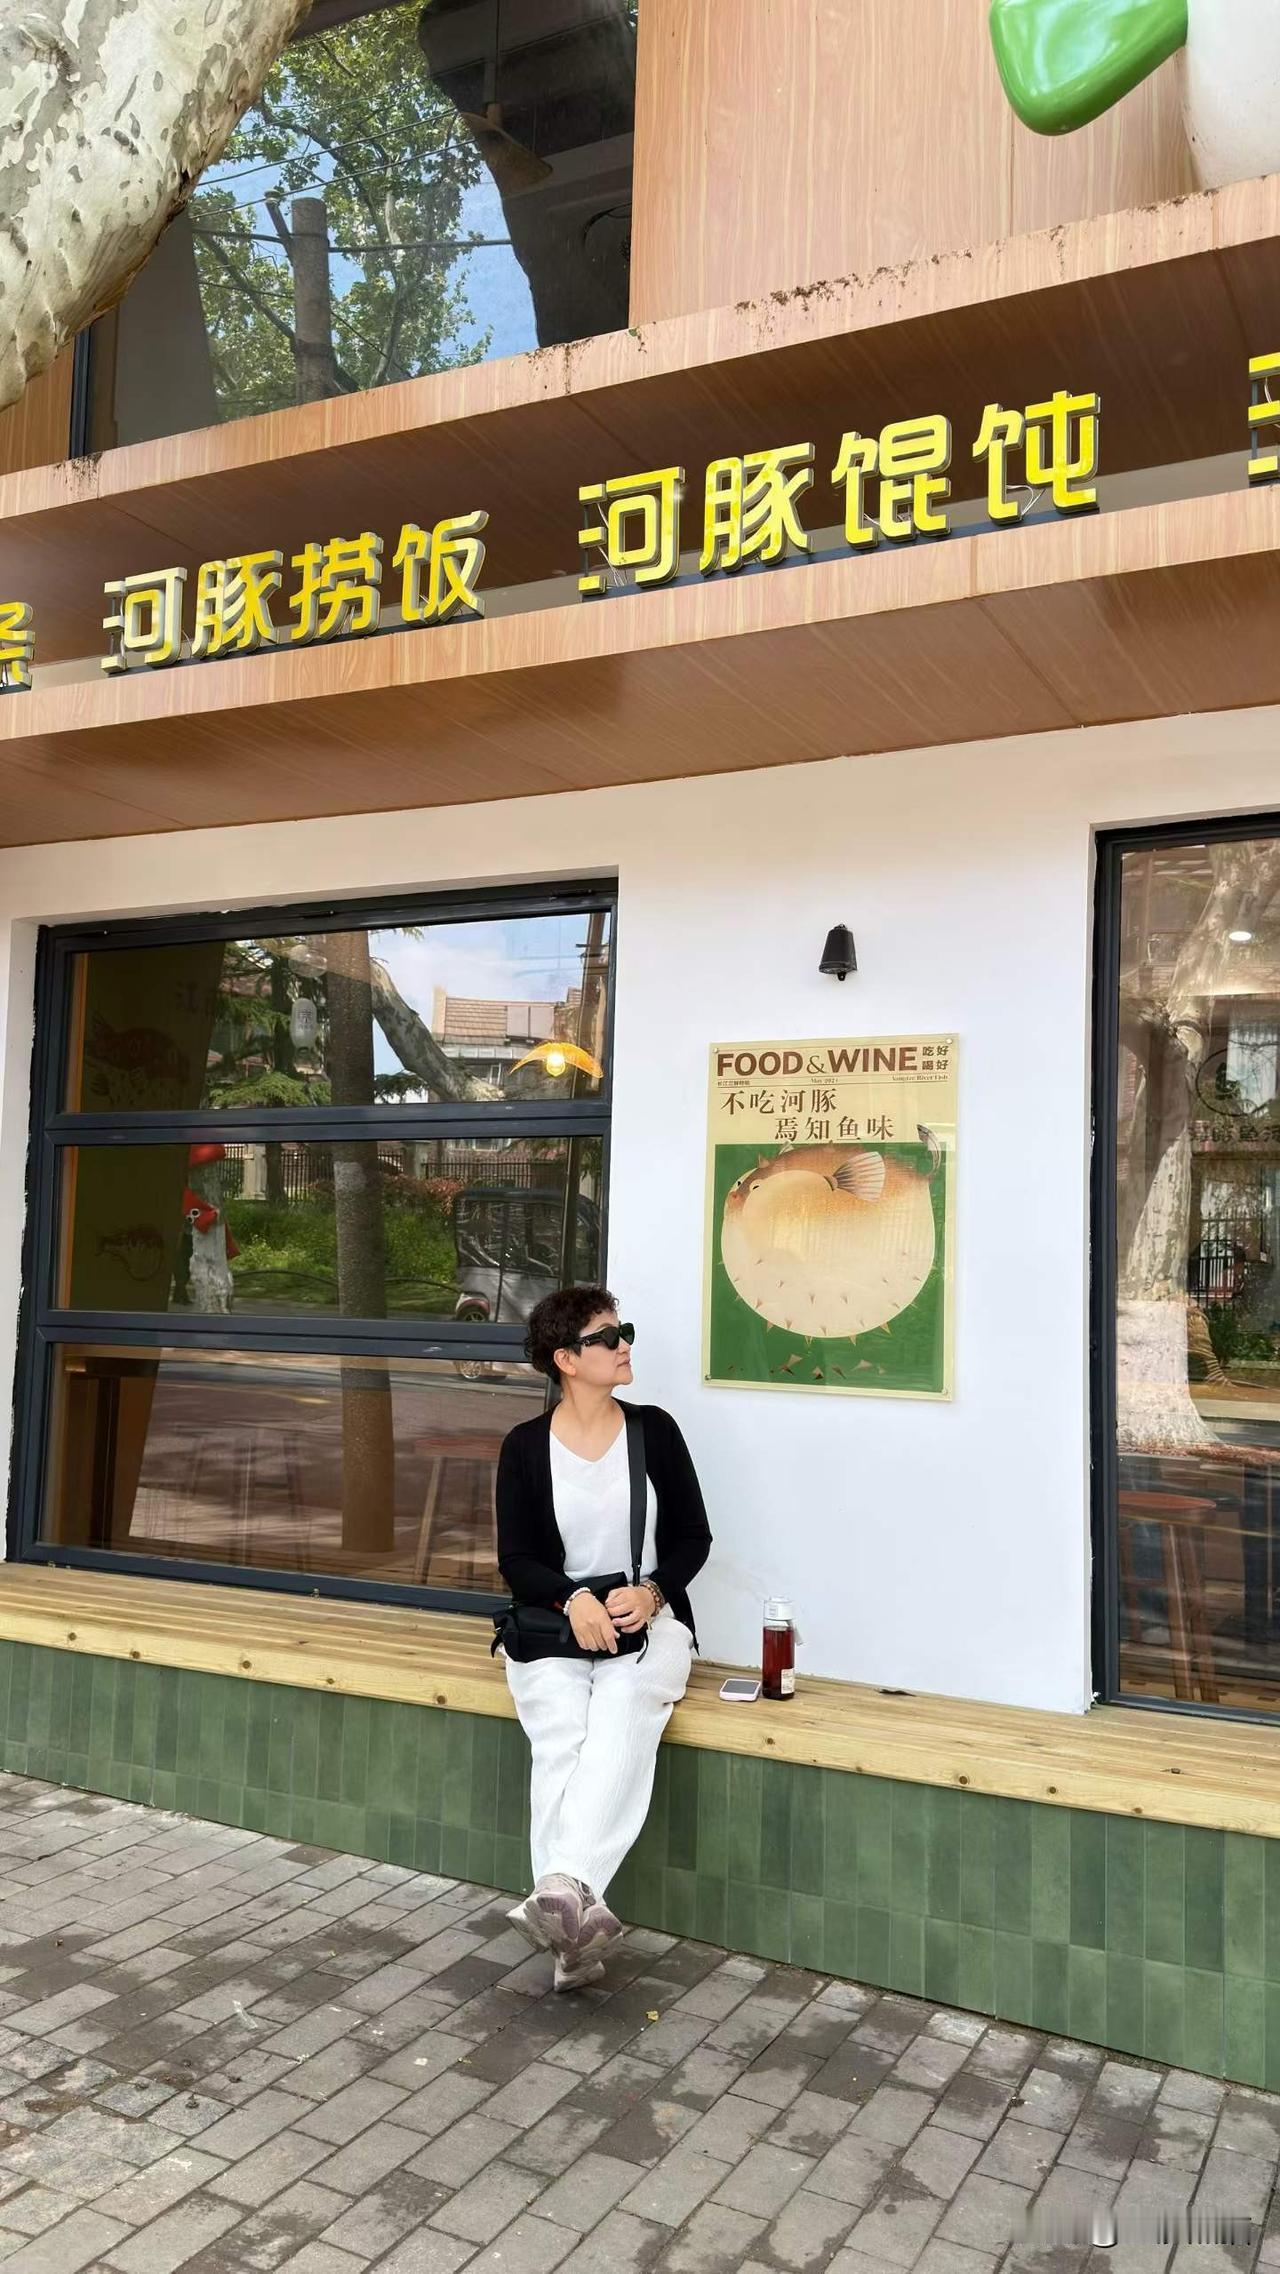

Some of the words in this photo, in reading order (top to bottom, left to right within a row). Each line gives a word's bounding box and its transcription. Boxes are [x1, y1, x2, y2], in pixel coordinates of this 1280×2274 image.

[578, 390, 1100, 595] 河豚馄饨
[101, 510, 490, 674] 河豚捞饭
[720, 1088, 837, 1115] 不吃河豚
[775, 1115, 894, 1141] 焉知鱼味
